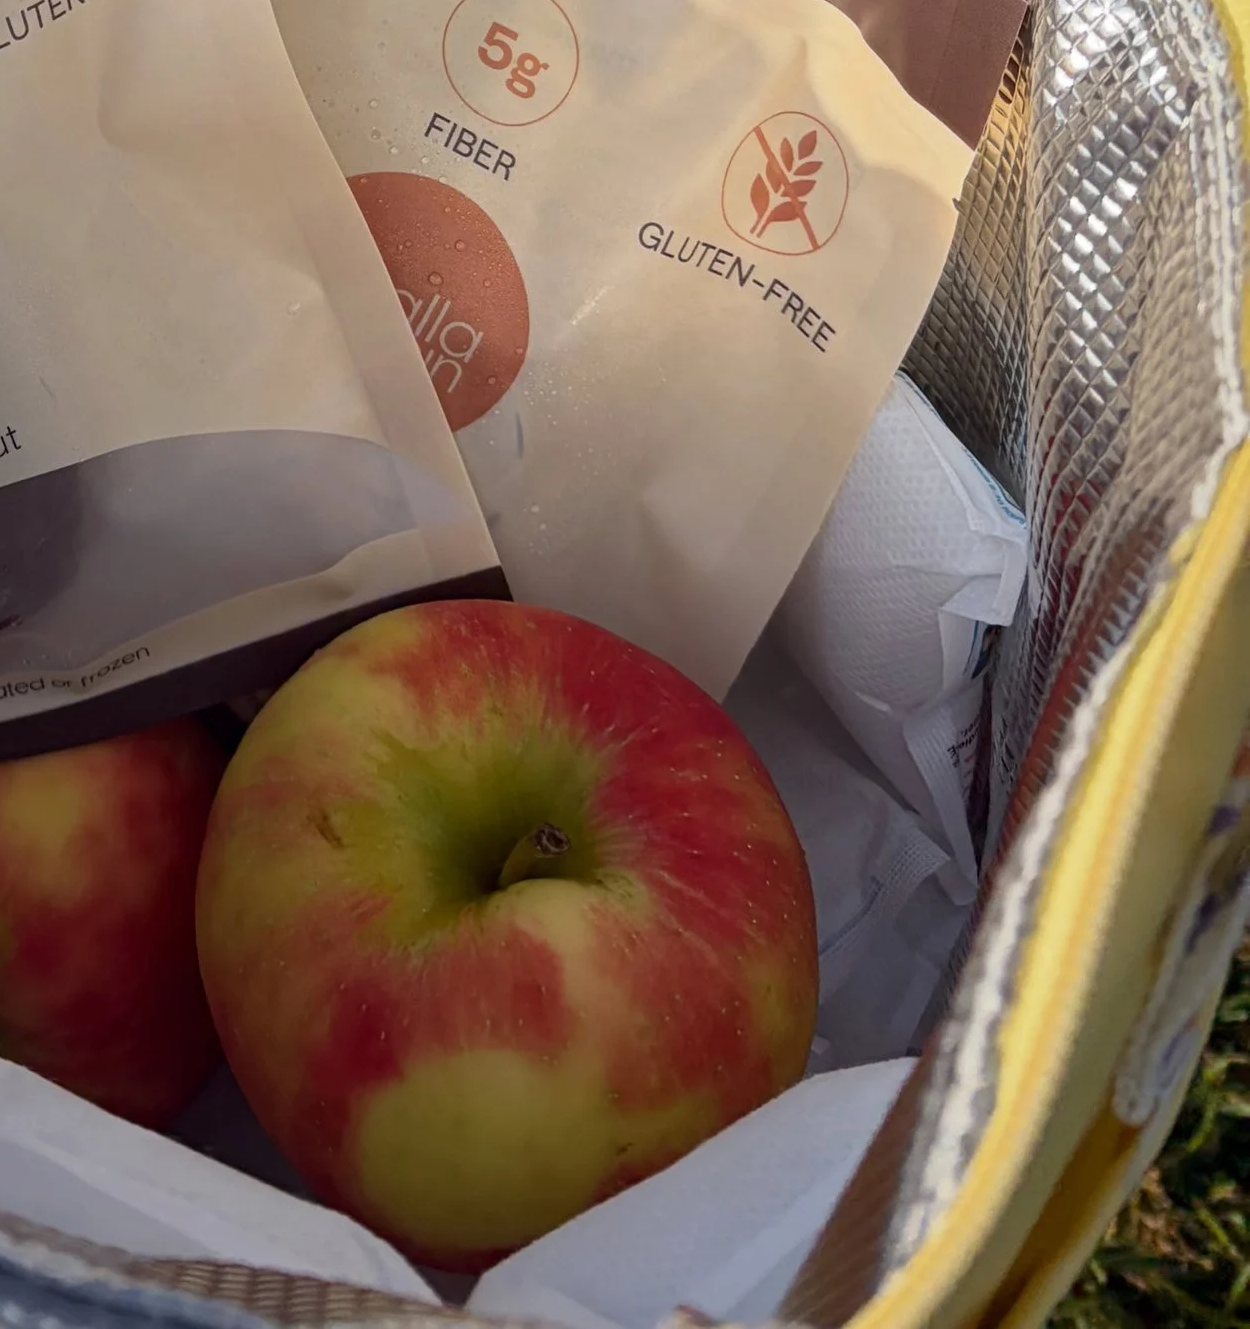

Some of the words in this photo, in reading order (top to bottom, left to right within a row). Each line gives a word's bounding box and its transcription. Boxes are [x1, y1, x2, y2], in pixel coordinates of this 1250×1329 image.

[477, 21, 550, 100] 5g
[424, 112, 516, 181] FIBER
[638, 222, 837, 353] GLUTEN-FREE
[81, 645, 150, 688] frozen
